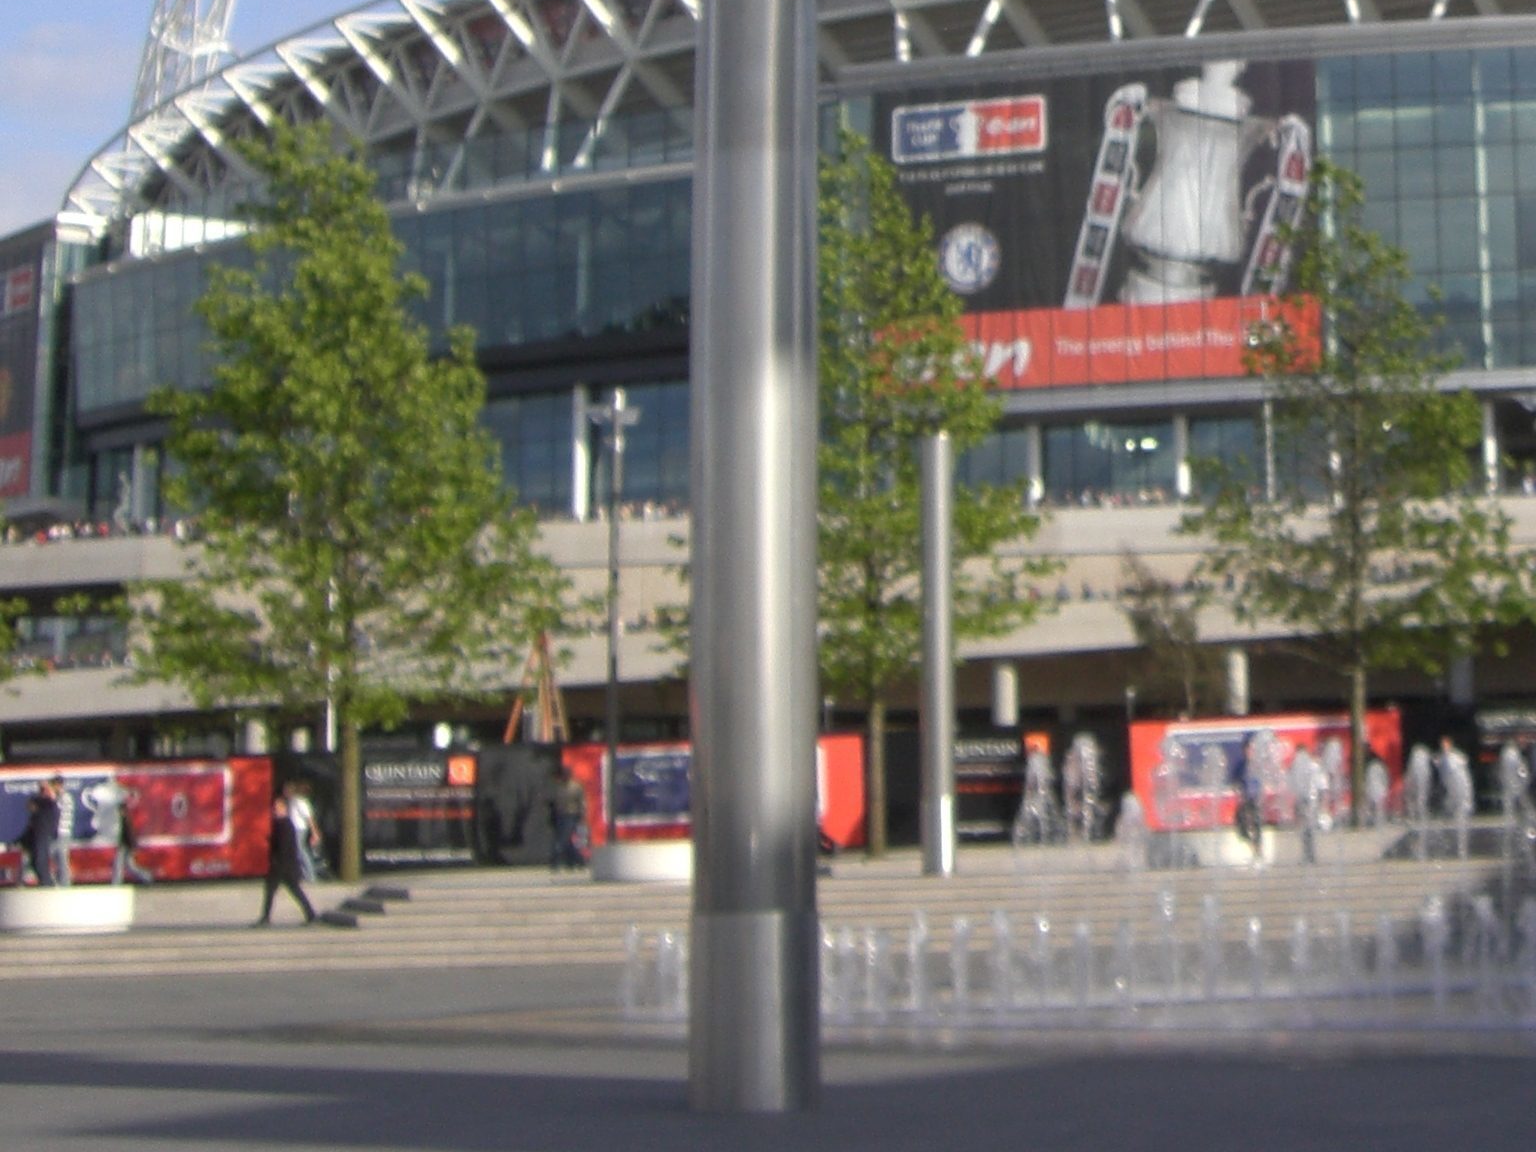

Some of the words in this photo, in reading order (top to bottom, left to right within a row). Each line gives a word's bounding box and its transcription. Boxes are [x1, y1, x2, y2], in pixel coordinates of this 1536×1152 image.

[1089, 338, 1141, 358] energy
[1145, 332, 1203, 351] behind
[365, 764, 442, 782] QUINTAIN
